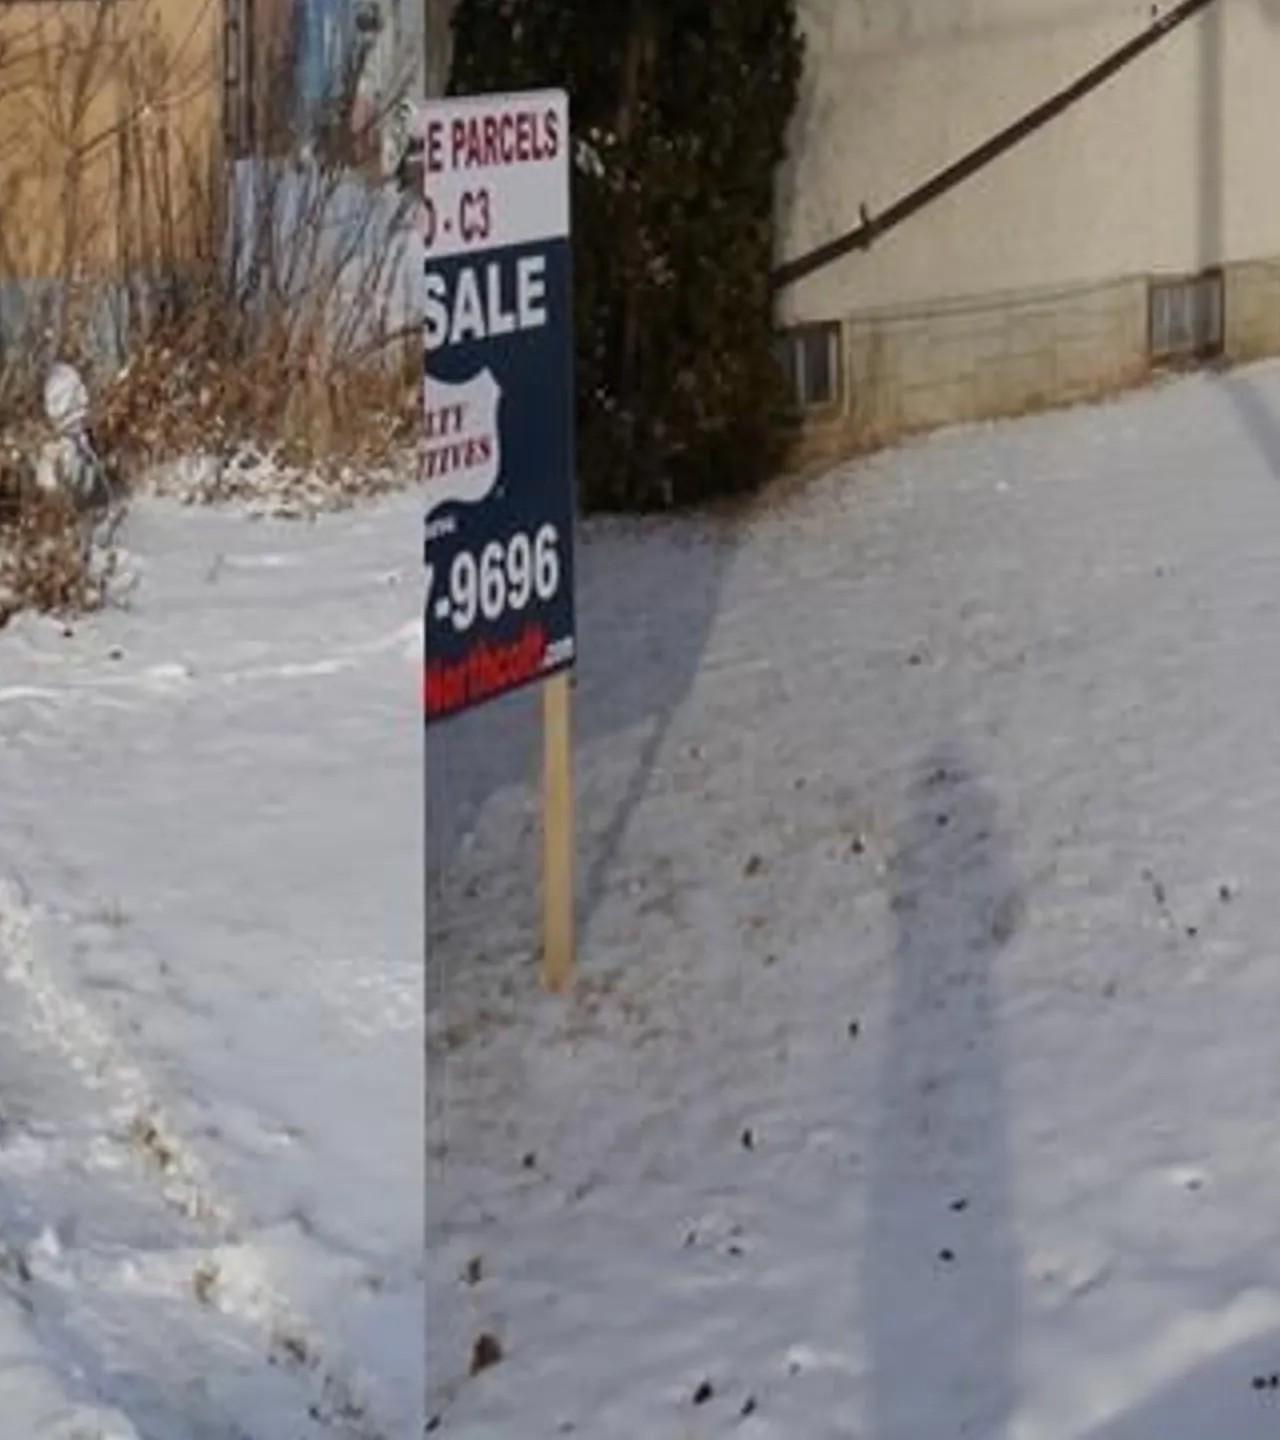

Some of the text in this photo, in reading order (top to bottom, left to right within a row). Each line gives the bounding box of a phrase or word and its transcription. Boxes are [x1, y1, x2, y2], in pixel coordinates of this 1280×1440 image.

[451, 108, 558, 170] PARCELS
[459, 188, 490, 243] C3
[424, 255, 547, 351] SALE
